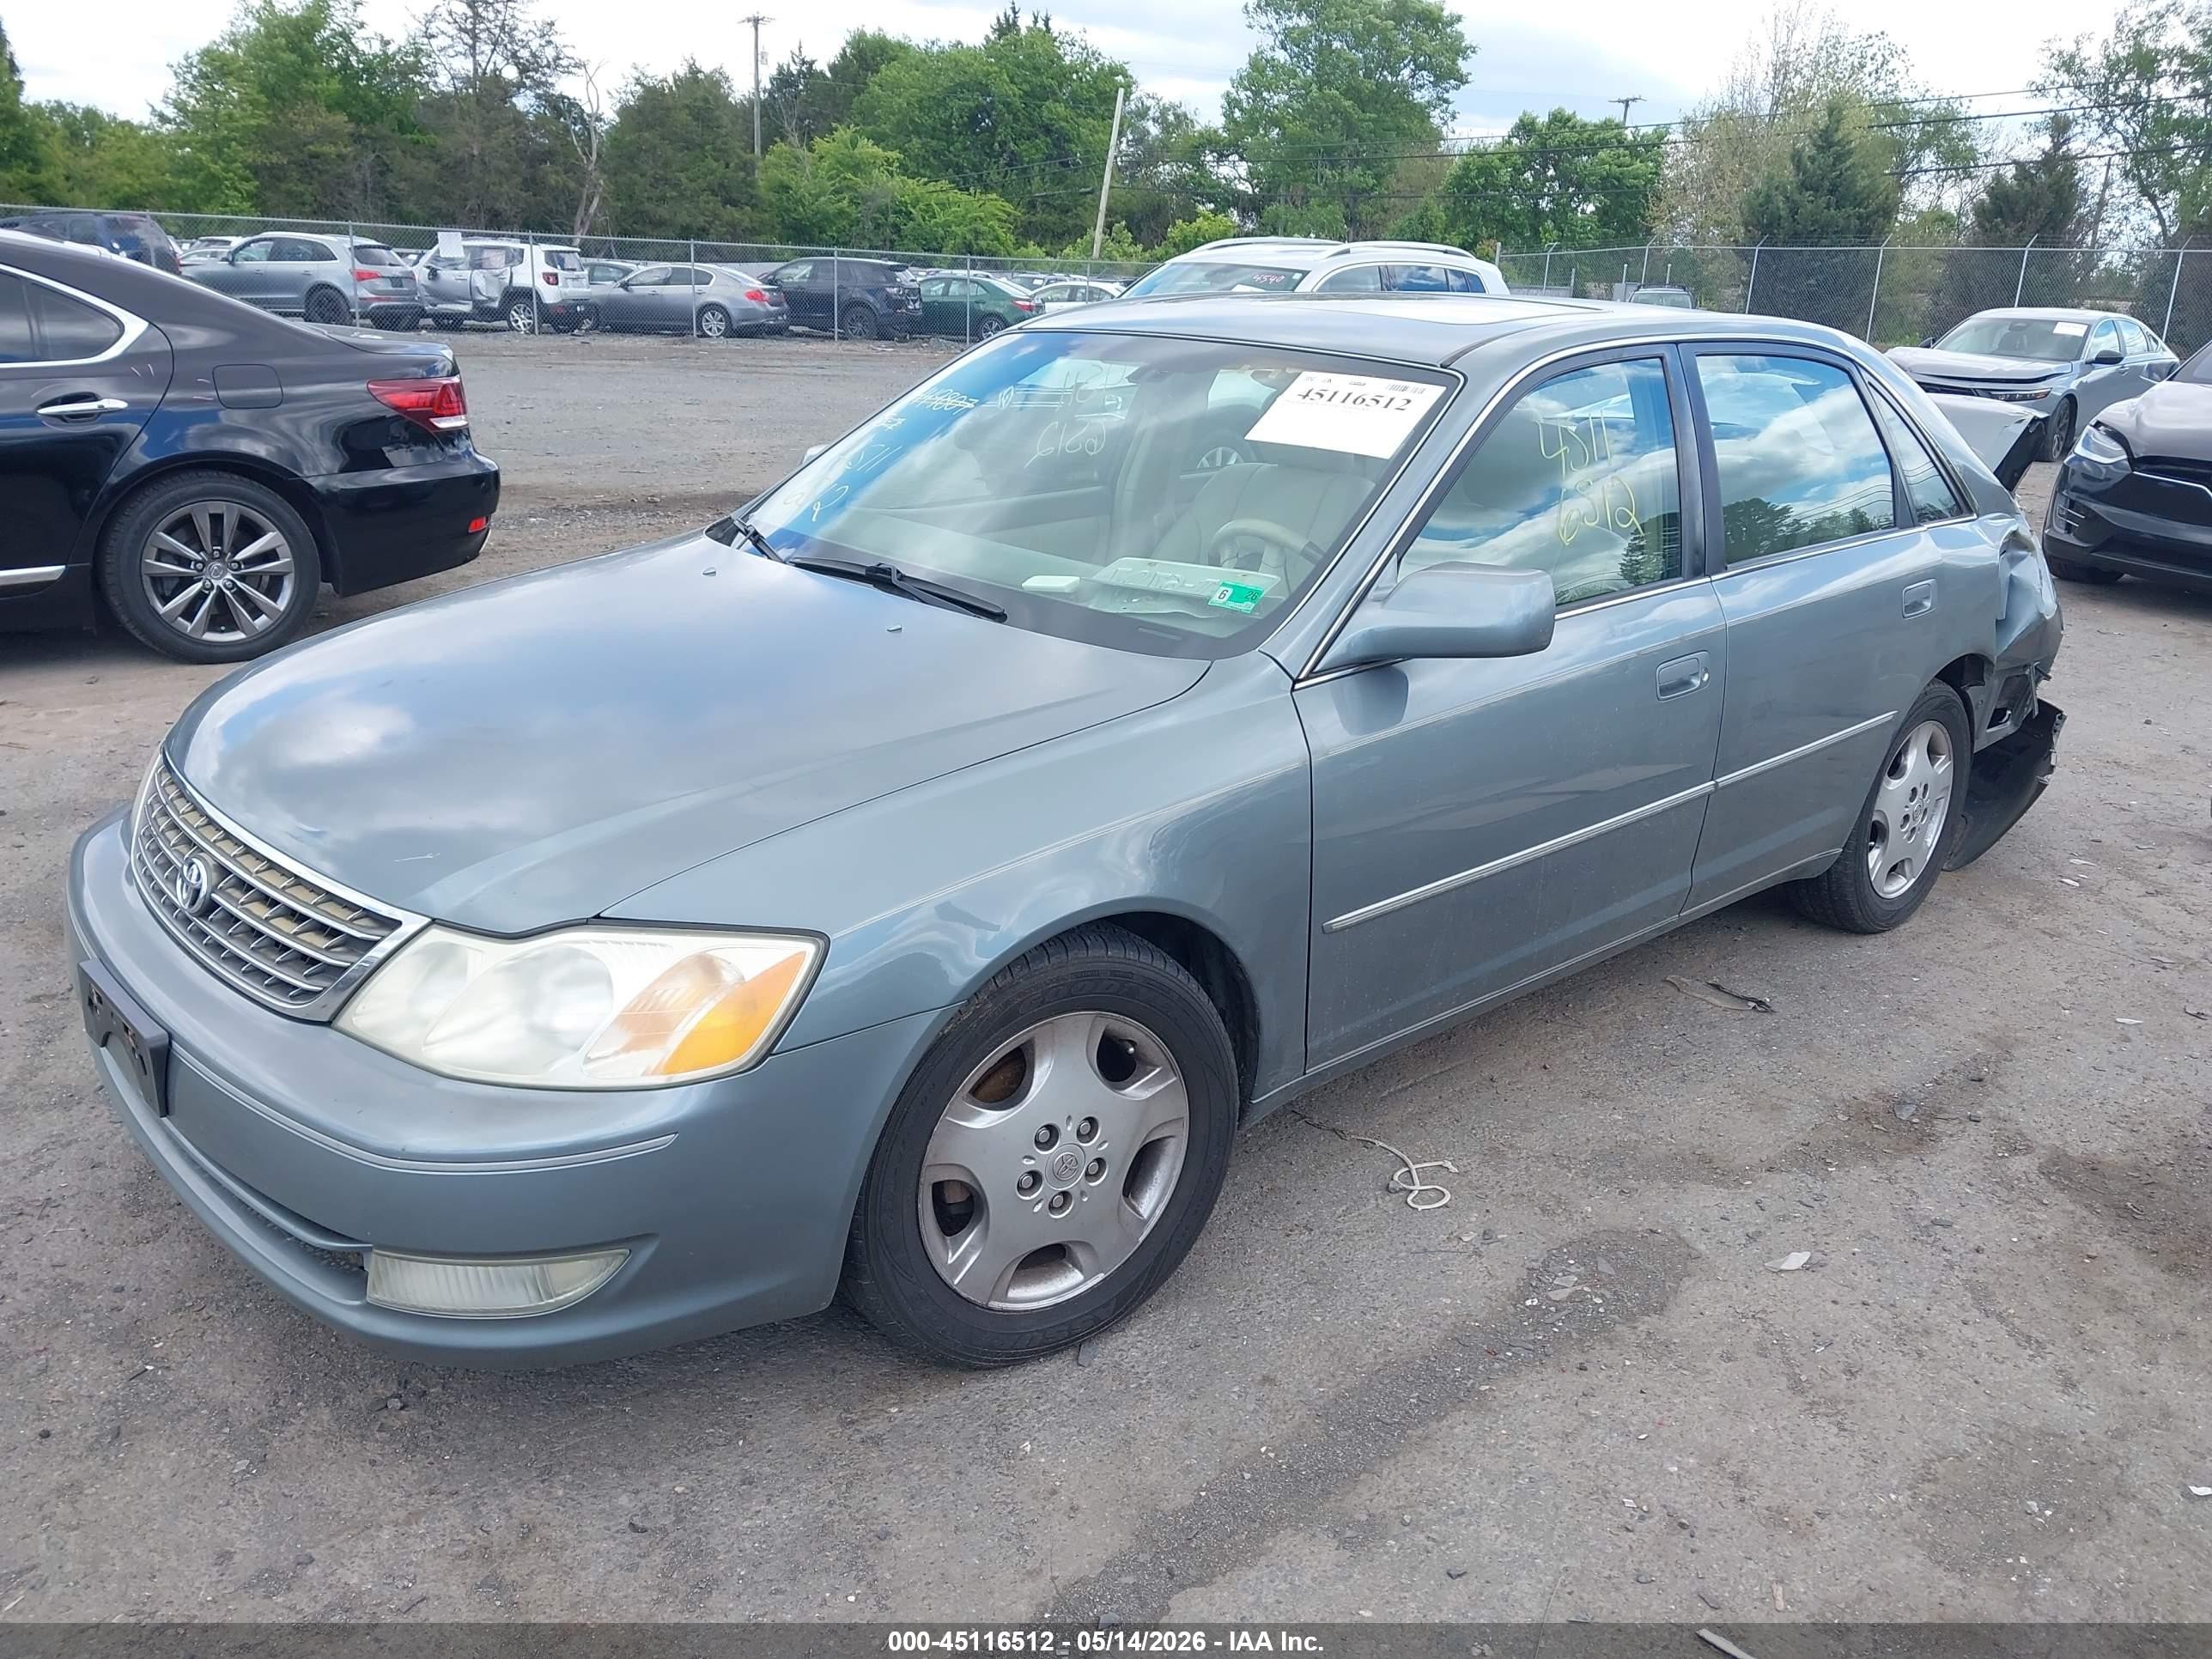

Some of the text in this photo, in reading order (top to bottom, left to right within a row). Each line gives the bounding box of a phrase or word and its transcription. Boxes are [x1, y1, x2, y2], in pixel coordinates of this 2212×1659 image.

[1297, 386, 1413, 412] 45116512
[1533, 410, 1612, 480] 4511
[1558, 476, 1646, 546] 6512
[1218, 589, 1229, 600] 6
